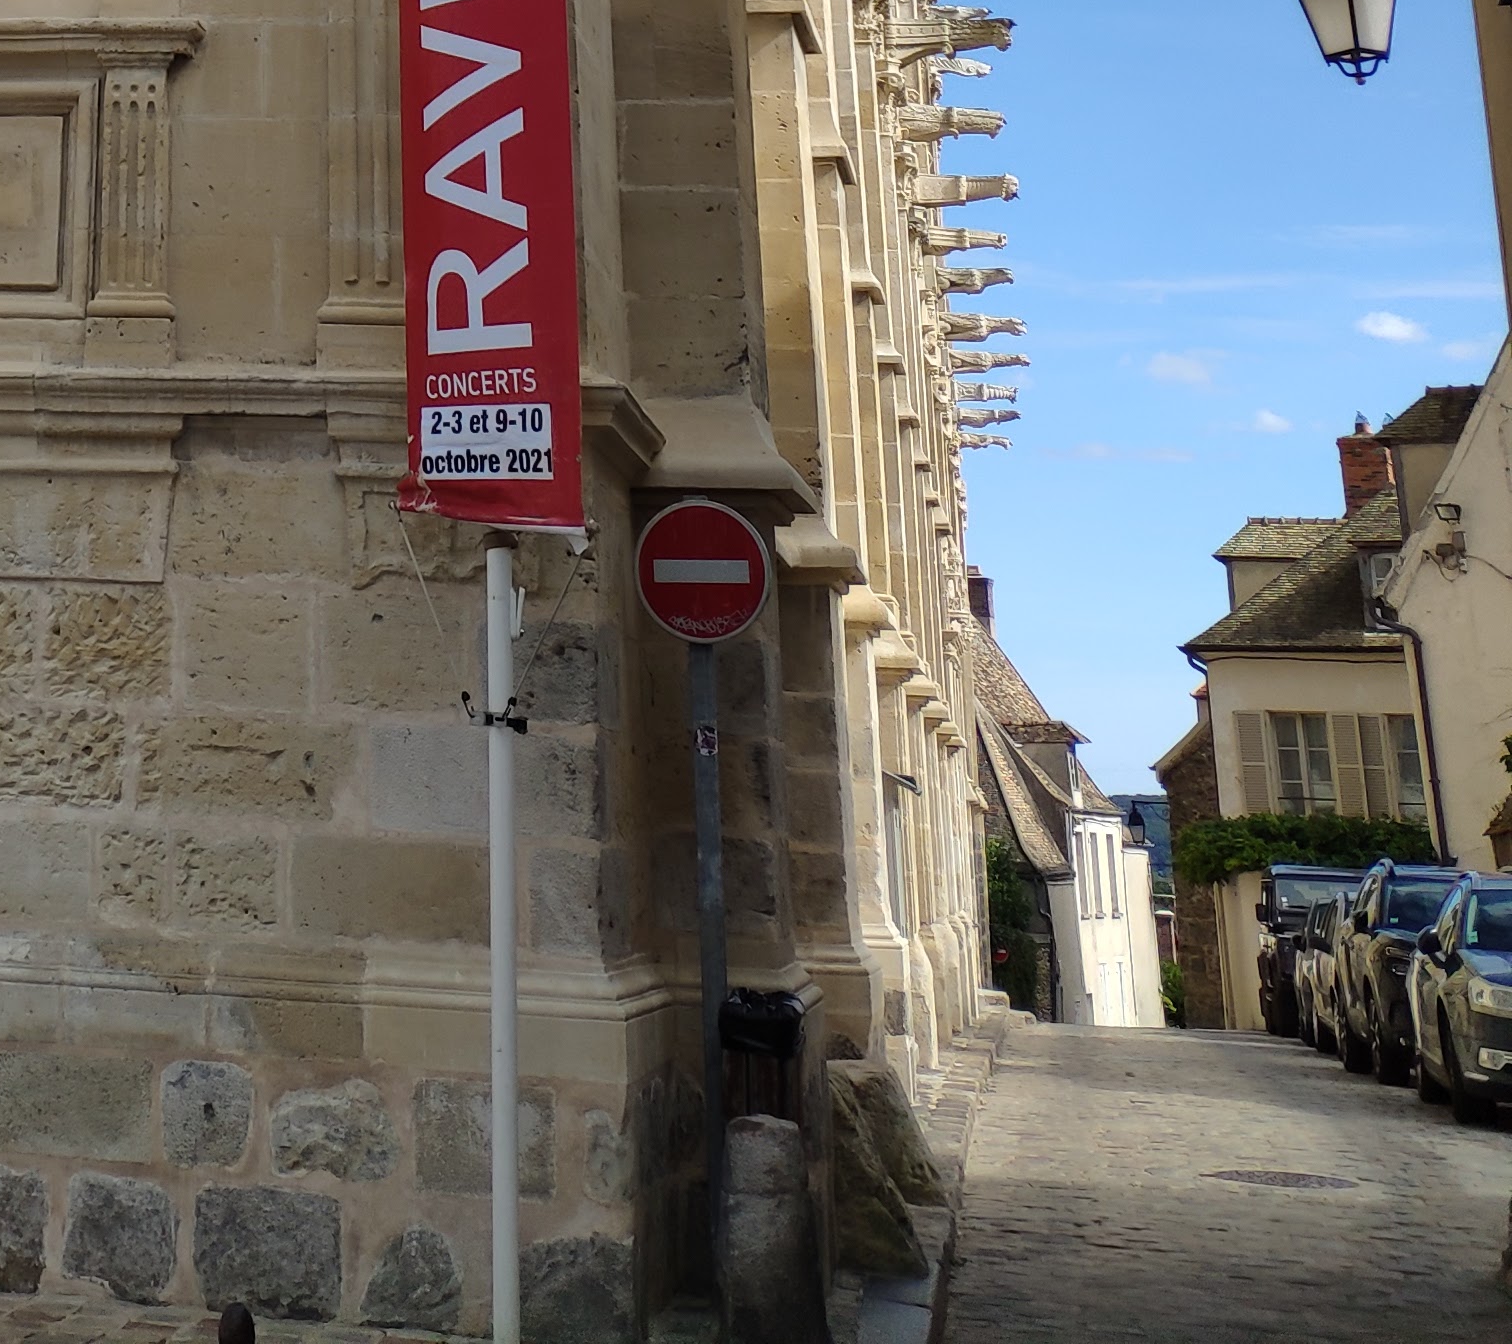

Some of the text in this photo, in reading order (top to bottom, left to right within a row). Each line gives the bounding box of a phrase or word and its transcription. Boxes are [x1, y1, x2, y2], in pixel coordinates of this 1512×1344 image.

[426, 367, 537, 399] CONCERTS
[431, 407, 543, 435] 2-3 et 9-10
[422, 447, 553, 475] octobre 2021
